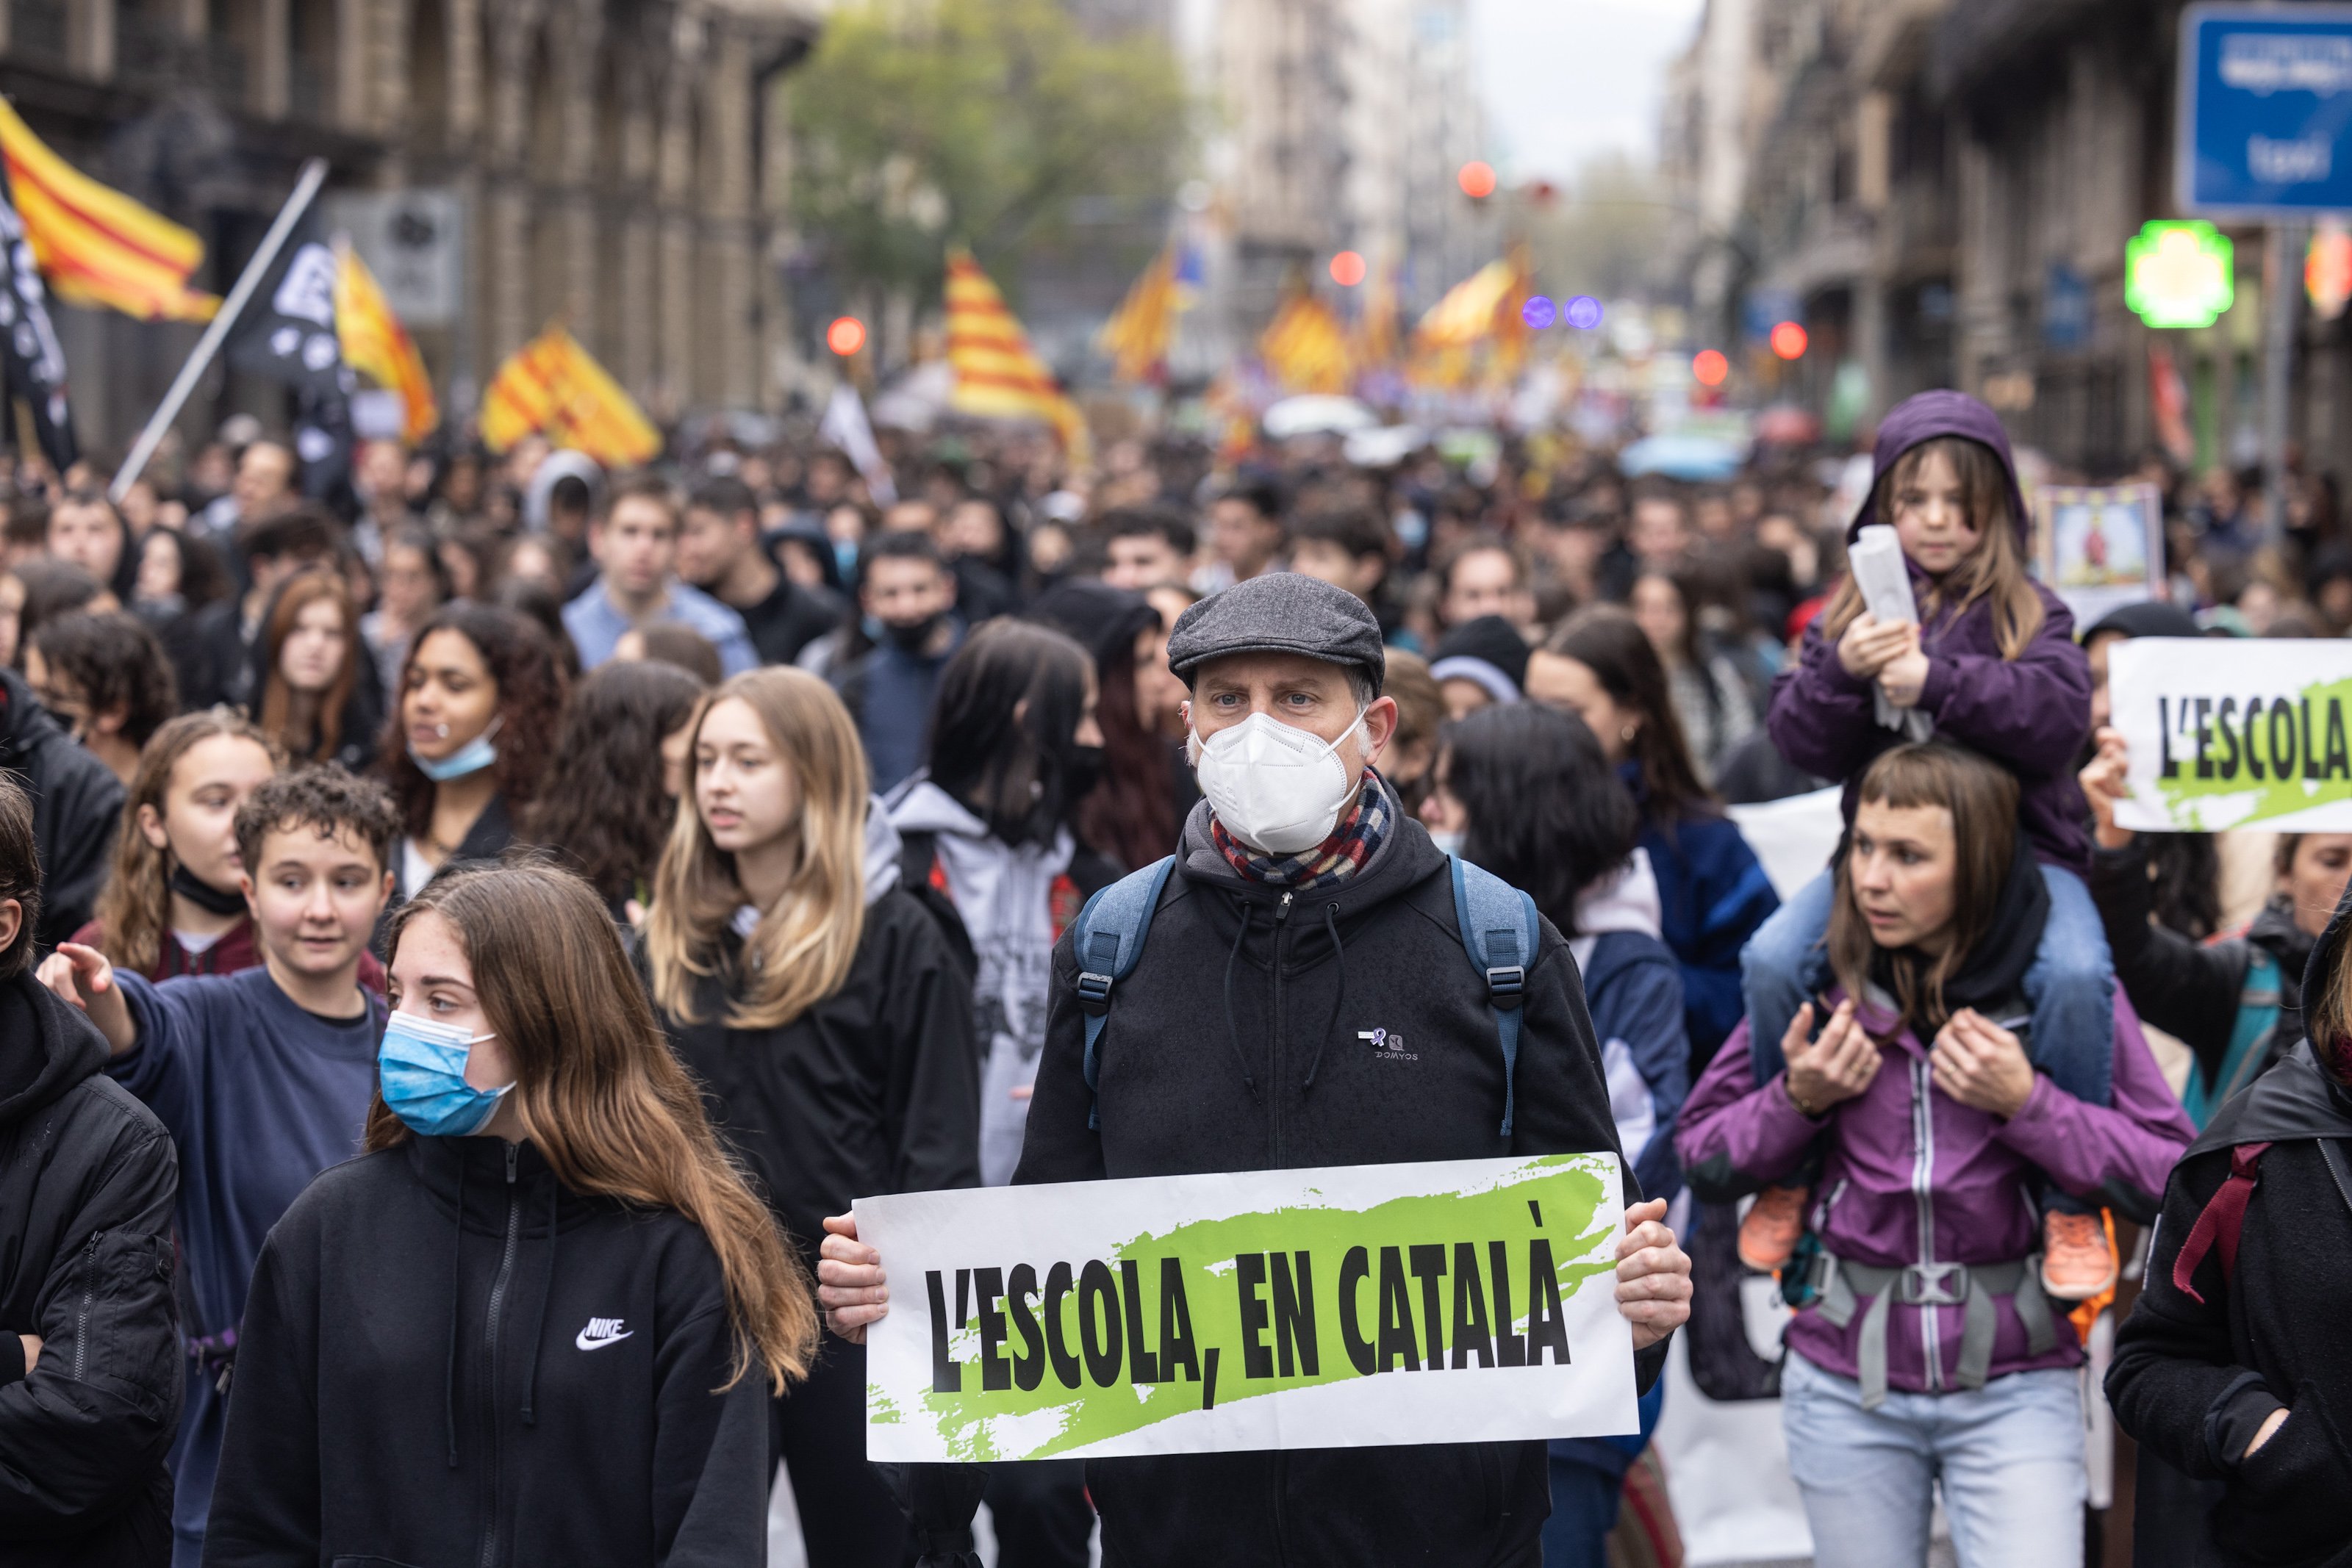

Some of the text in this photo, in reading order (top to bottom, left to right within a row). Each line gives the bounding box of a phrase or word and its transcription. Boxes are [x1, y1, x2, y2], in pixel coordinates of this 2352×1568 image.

[1374, 1051, 1419, 1060] DOMYOS
[925, 1199, 1571, 1411] L'ESCOLA, EN CATALÀ
[585, 1317, 625, 1338] NIKE
